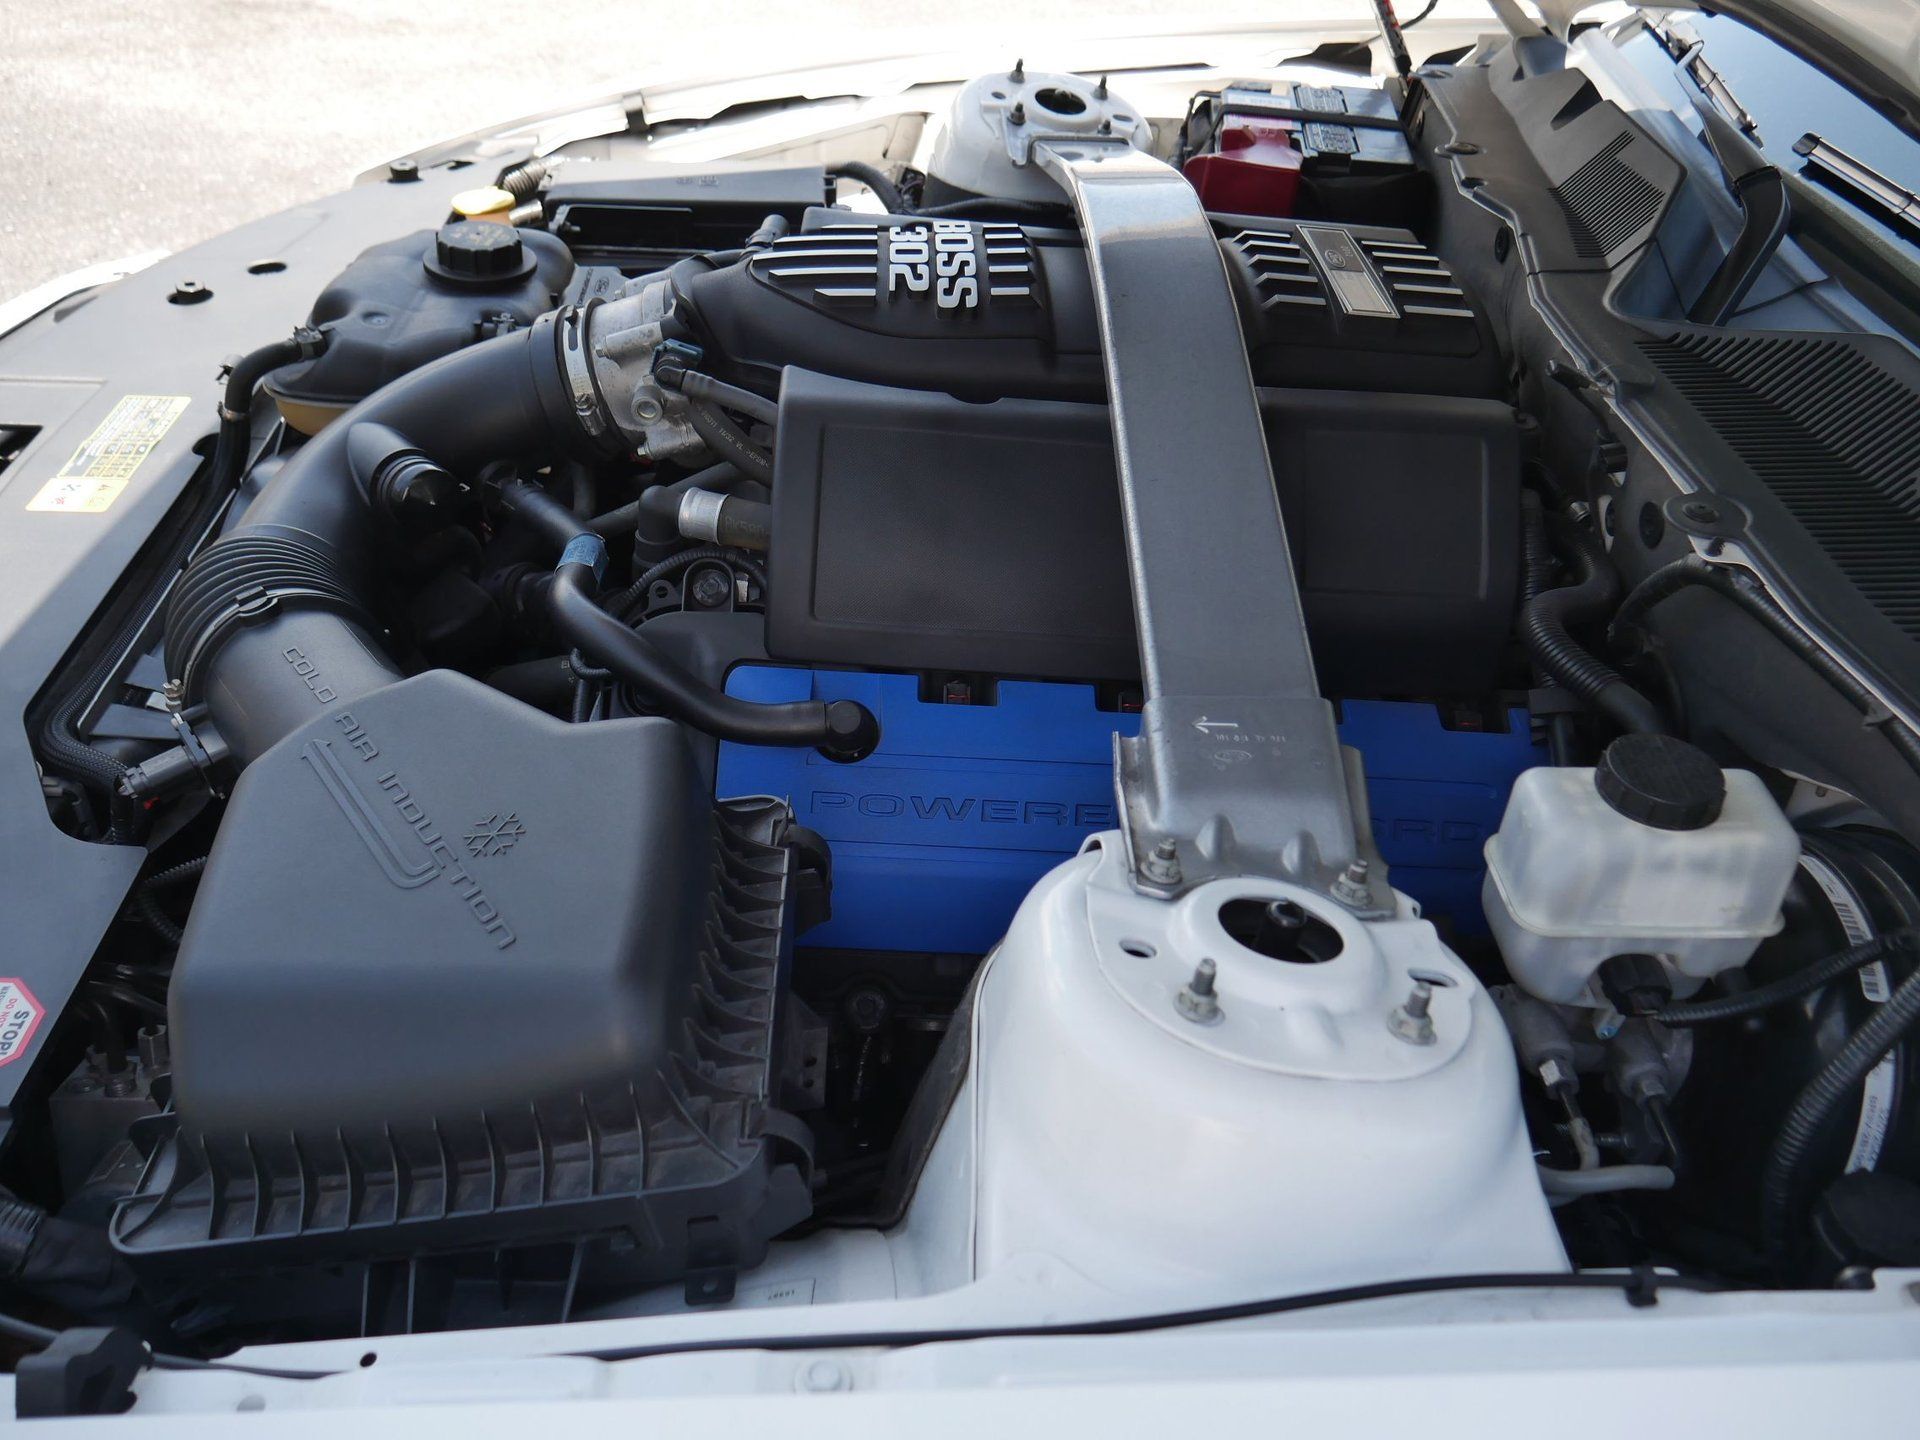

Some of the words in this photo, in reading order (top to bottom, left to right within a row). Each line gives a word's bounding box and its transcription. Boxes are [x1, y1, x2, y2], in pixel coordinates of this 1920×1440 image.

[889, 226, 930, 292] 302
[933, 221, 978, 309] BOSS
[282, 646, 338, 704] COLD
[334, 711, 379, 762] AIR
[376, 770, 517, 950] INDUCTION
[810, 791, 1120, 827] POWERE
